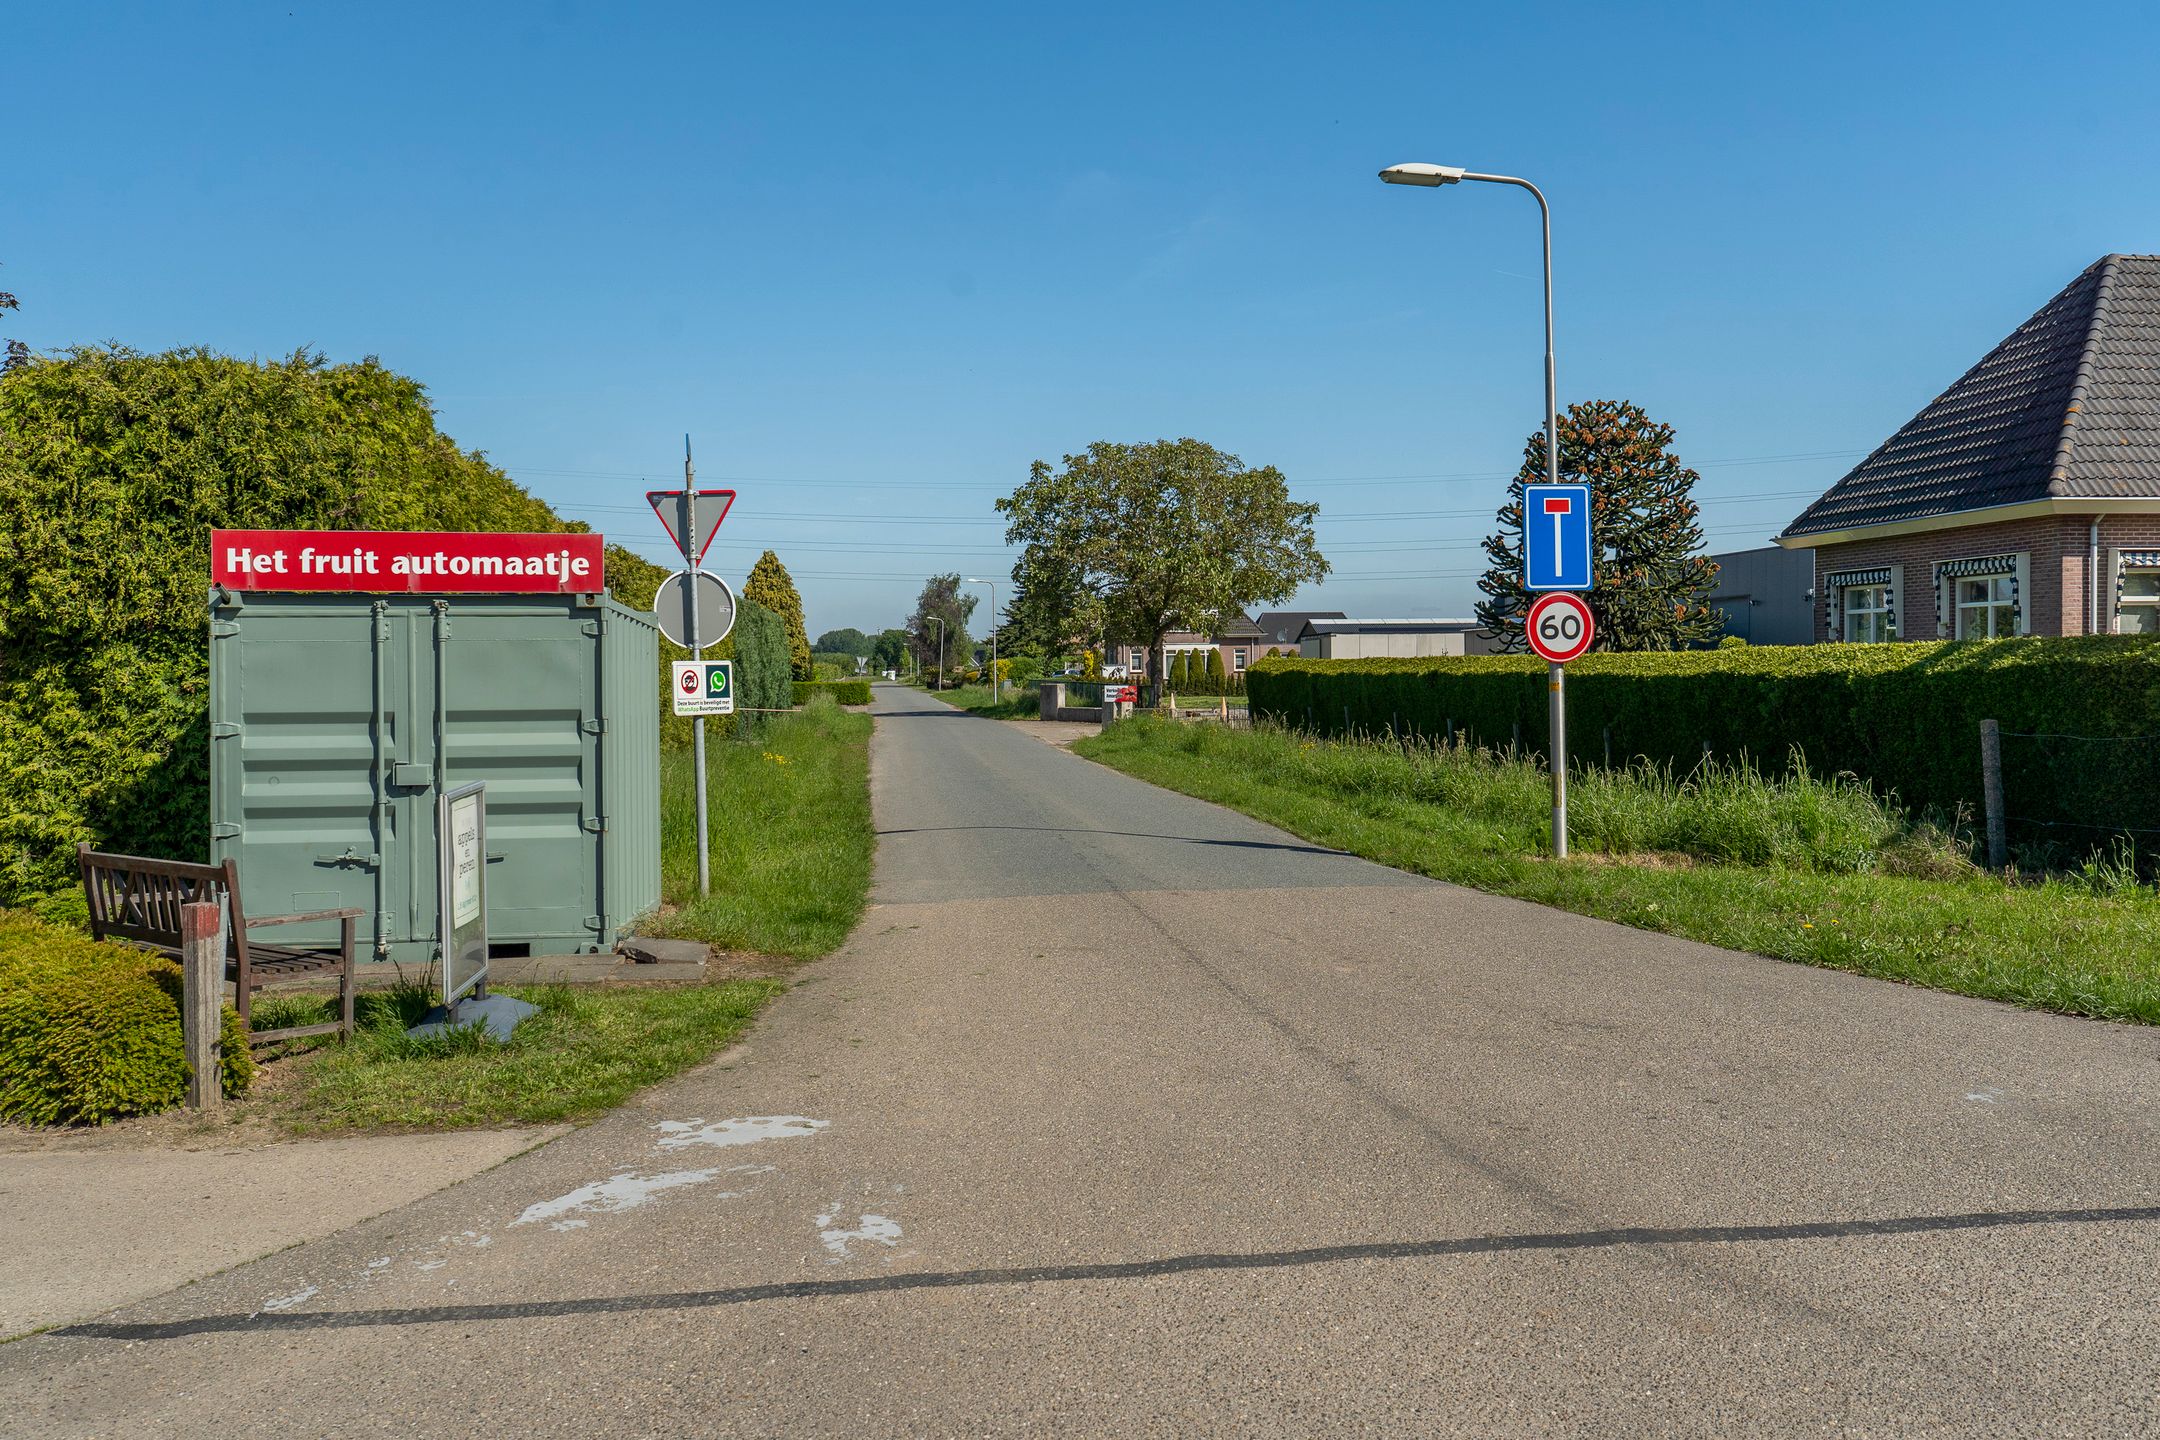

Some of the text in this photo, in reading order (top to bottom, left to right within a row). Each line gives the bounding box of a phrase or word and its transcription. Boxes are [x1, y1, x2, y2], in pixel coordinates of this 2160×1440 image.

[226, 548, 589, 583] Het fruit automaatje
[1540, 614, 1580, 640] 60
[457, 826, 475, 847] appels
[459, 859, 475, 878] peren
